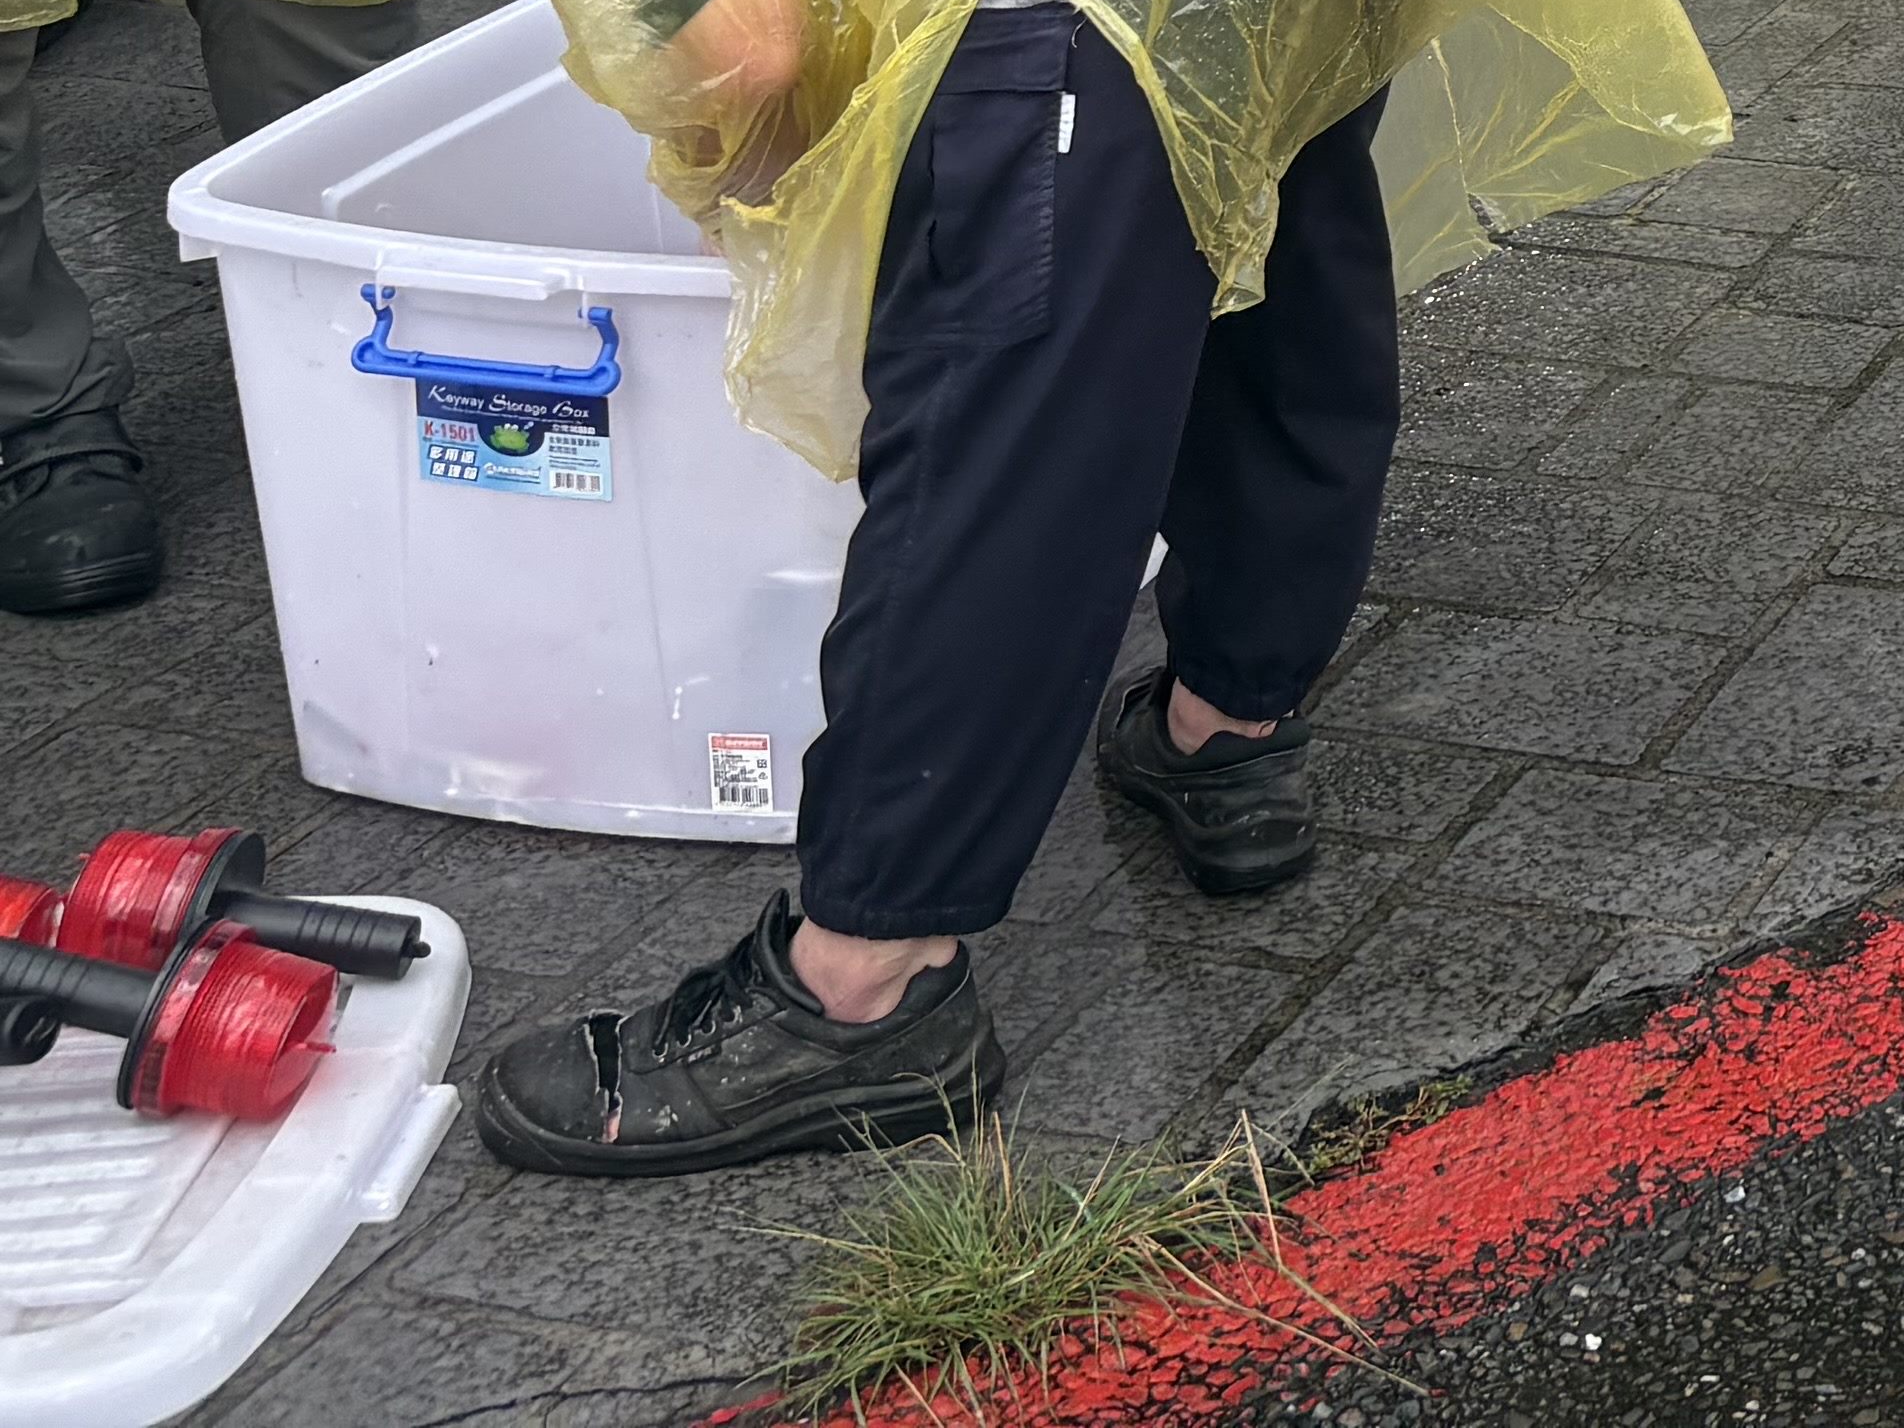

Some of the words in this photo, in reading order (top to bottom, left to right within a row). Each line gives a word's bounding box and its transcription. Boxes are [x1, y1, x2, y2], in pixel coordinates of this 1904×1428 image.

[428, 385, 484, 409] Keyway
[489, 394, 547, 416] Storage
[552, 401, 589, 418] Box
[423, 421, 475, 442] K-1501
